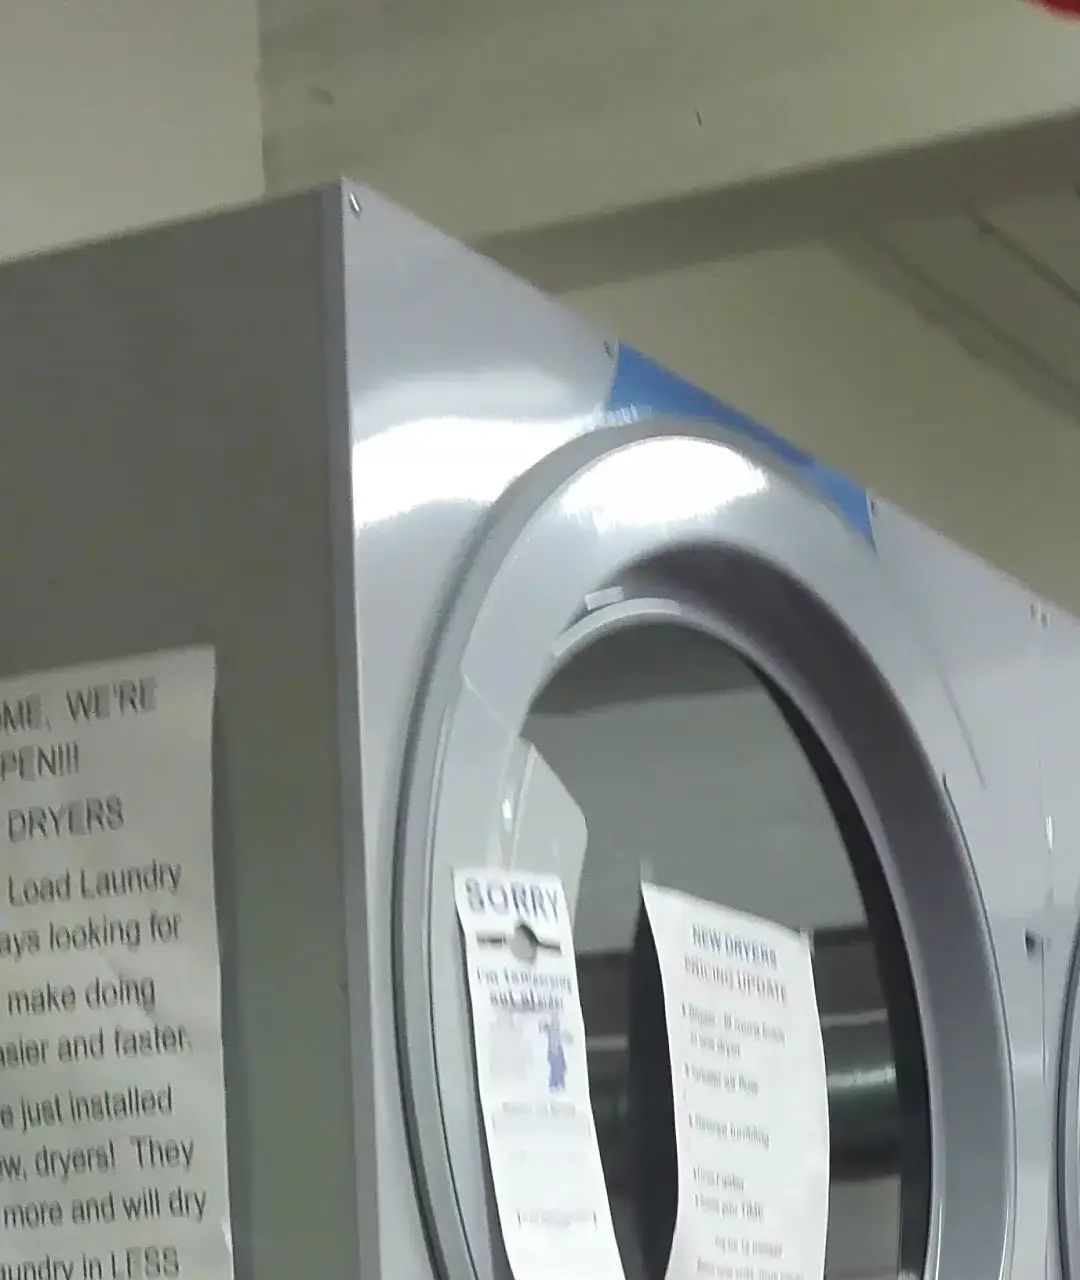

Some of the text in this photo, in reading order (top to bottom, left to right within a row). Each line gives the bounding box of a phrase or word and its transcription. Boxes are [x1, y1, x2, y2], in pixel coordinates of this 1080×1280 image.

[66, 676, 157, 723] WE'RE
[8, 794, 124, 843] DRYERS
[9, 858, 182, 907] Load Laundry
[464, 878, 560, 924] SORRY
[50, 914, 141, 953] looking
[151, 909, 182, 944] for
[692, 923, 779, 971] NEW DRYERS
[8, 974, 156, 1016] make doing
[737, 968, 788, 1007] UPDATE
[58, 1026, 104, 1063] and
[20, 1093, 63, 1135] just
[68, 1081, 173, 1124] installed
[35, 1137, 115, 1185] dryers!
[129, 1134, 194, 1173] They
[4, 1185, 207, 1229] more and will dry
[111, 1245, 180, 1280] LESS
